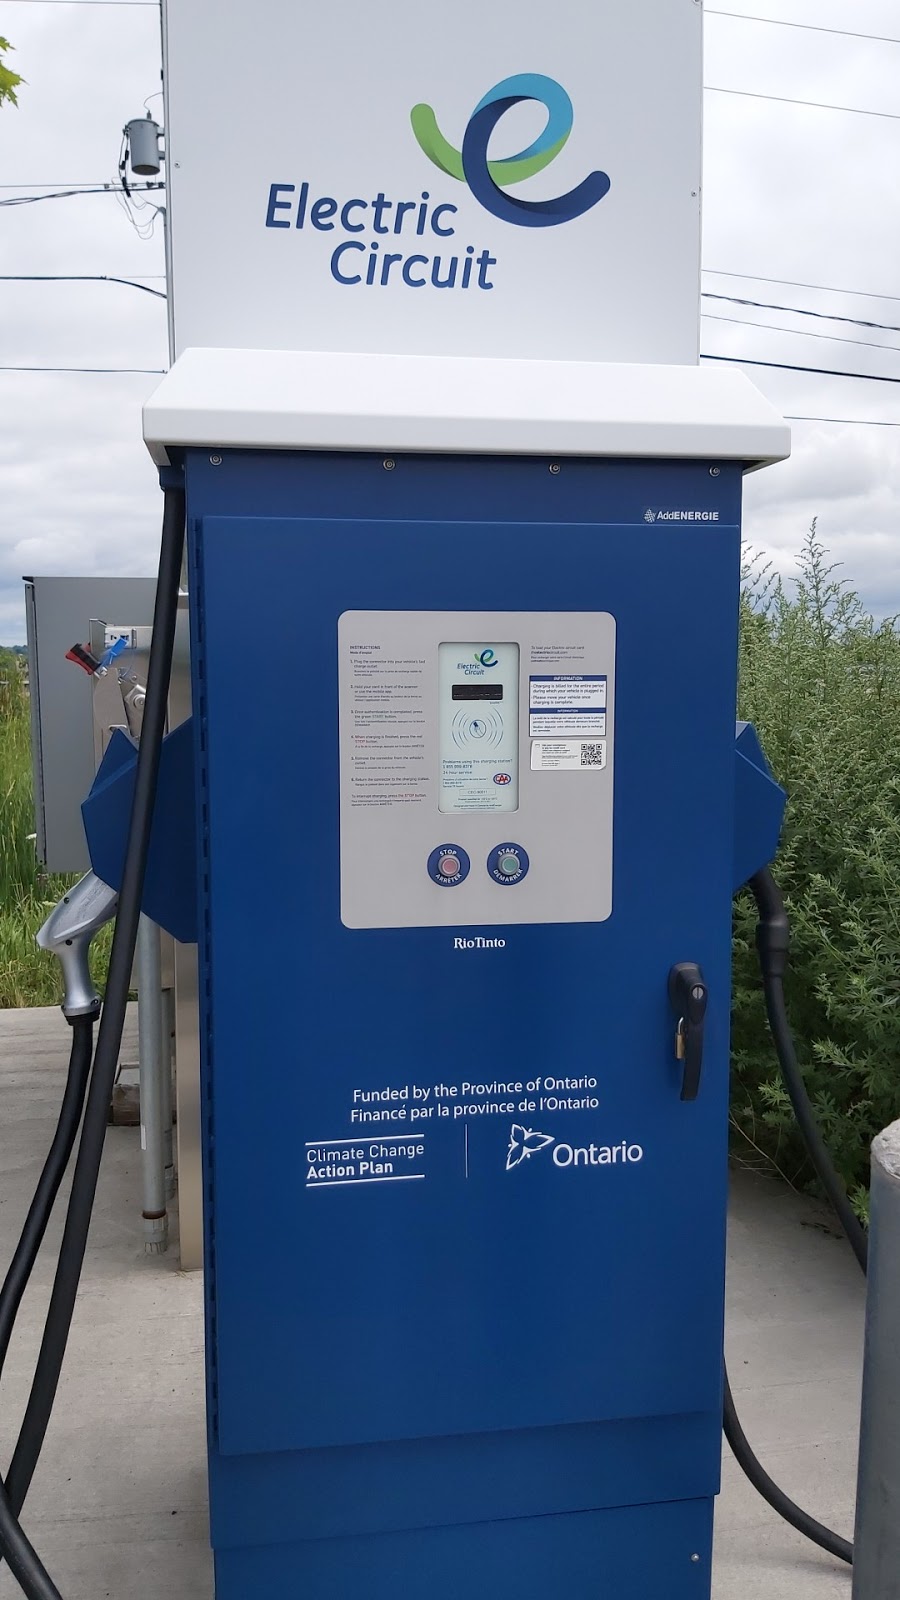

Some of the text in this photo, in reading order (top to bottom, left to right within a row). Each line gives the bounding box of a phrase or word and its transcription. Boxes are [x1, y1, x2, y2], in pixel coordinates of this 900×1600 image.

[265, 182, 458, 236] Electric
[331, 241, 496, 290] Circuit
[657, 511, 719, 520] AddENERGIE
[498, 848, 519, 856] START
[353, 1075, 597, 1102] Funded by the Province of Ontario
[350, 1096, 599, 1122] Financé par la province de l'Ontario
[307, 1143, 424, 1162] Climate Change
[552, 1141, 643, 1167] Ontario
[307, 1160, 393, 1179] Action Plan
